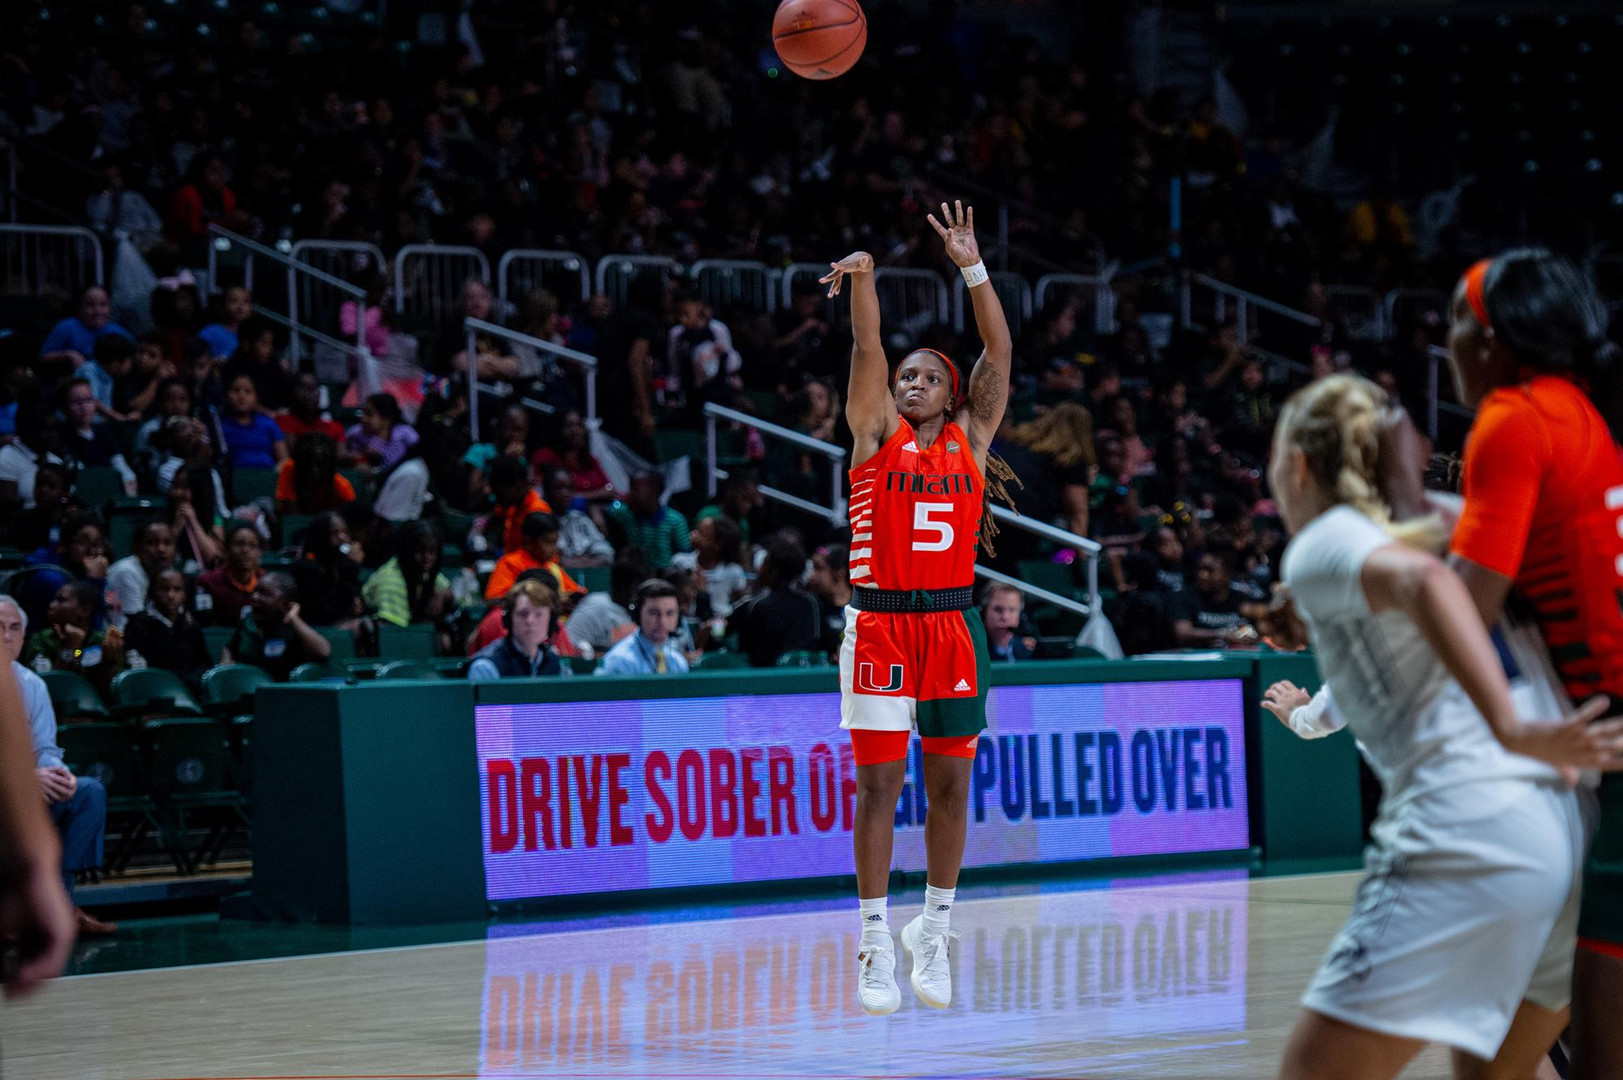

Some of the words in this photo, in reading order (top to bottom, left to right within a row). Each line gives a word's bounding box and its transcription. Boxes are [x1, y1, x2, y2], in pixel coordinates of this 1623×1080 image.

[912, 501, 955, 552] 5
[859, 662, 904, 692] U
[487, 753, 634, 854] DRIVE
[644, 745, 799, 843] SOBER
[973, 730, 1124, 824] PULLED
[1131, 727, 1234, 814] OVER
